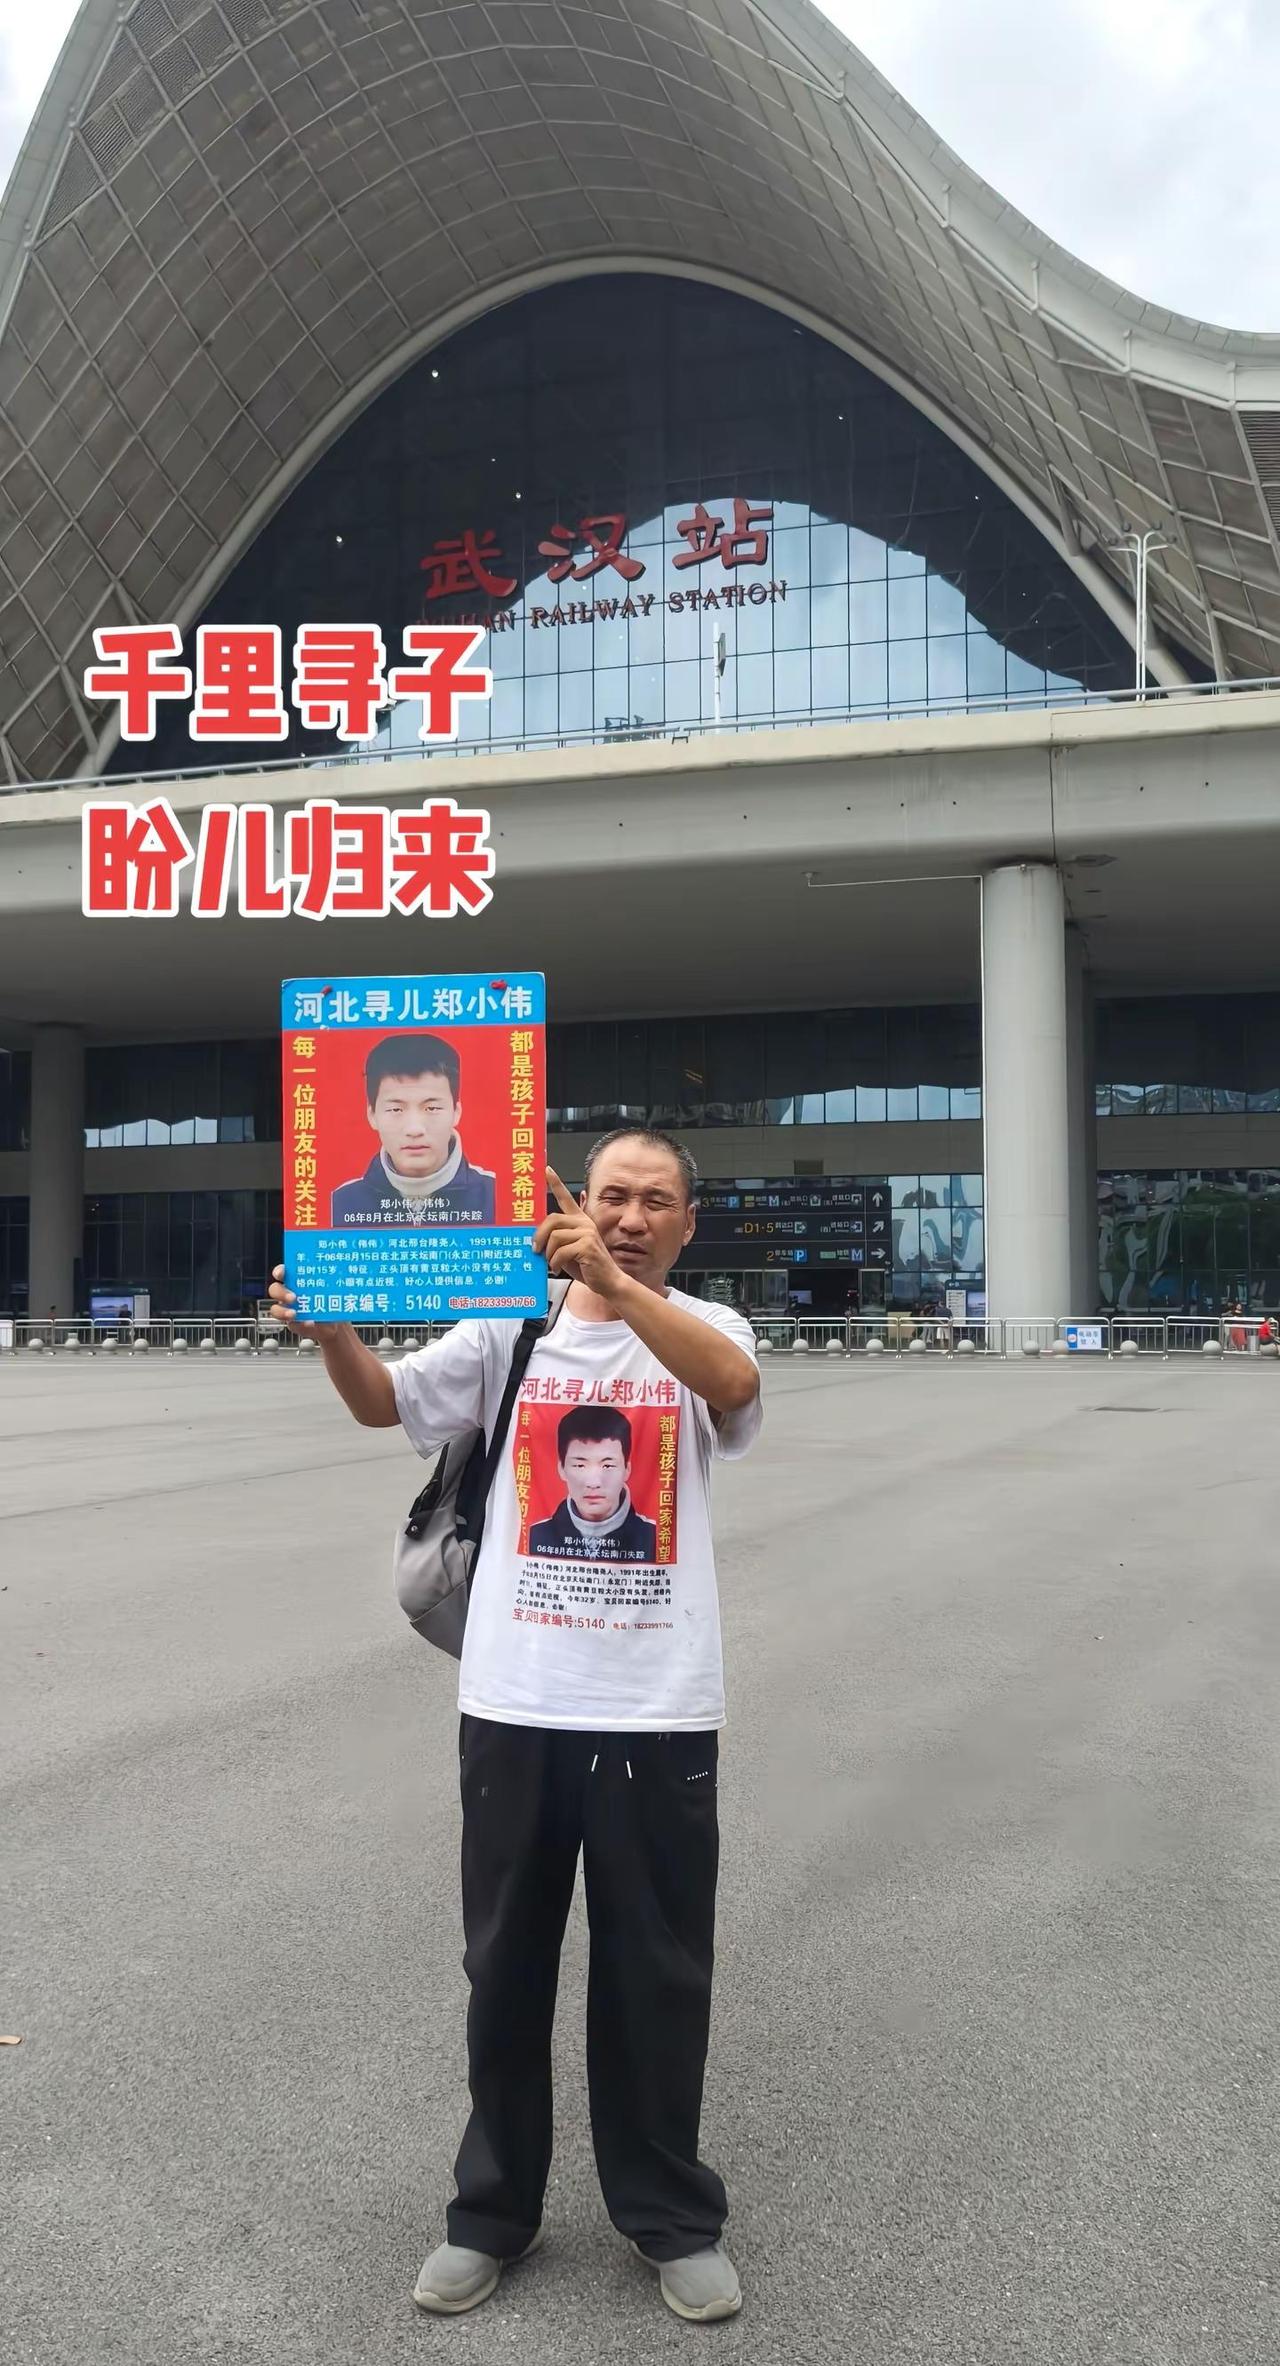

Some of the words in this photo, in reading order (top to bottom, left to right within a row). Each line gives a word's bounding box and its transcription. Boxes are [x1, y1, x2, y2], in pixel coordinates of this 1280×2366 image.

[420, 497, 778, 600] 武汉站
[530, 593, 656, 630] RAILWAY
[669, 580, 791, 615] STATION
[293, 985, 533, 1024] 河北寻儿郑小伟
[293, 1035, 317, 1228] 每一位朋友的关注
[510, 1030, 535, 1223] 都是孩子回家希望
[405, 1294, 441, 1311] 5140
[521, 1377, 677, 1405] 河北寻儿郑小伟
[658, 1415, 677, 1563] 都是孩子回家希望
